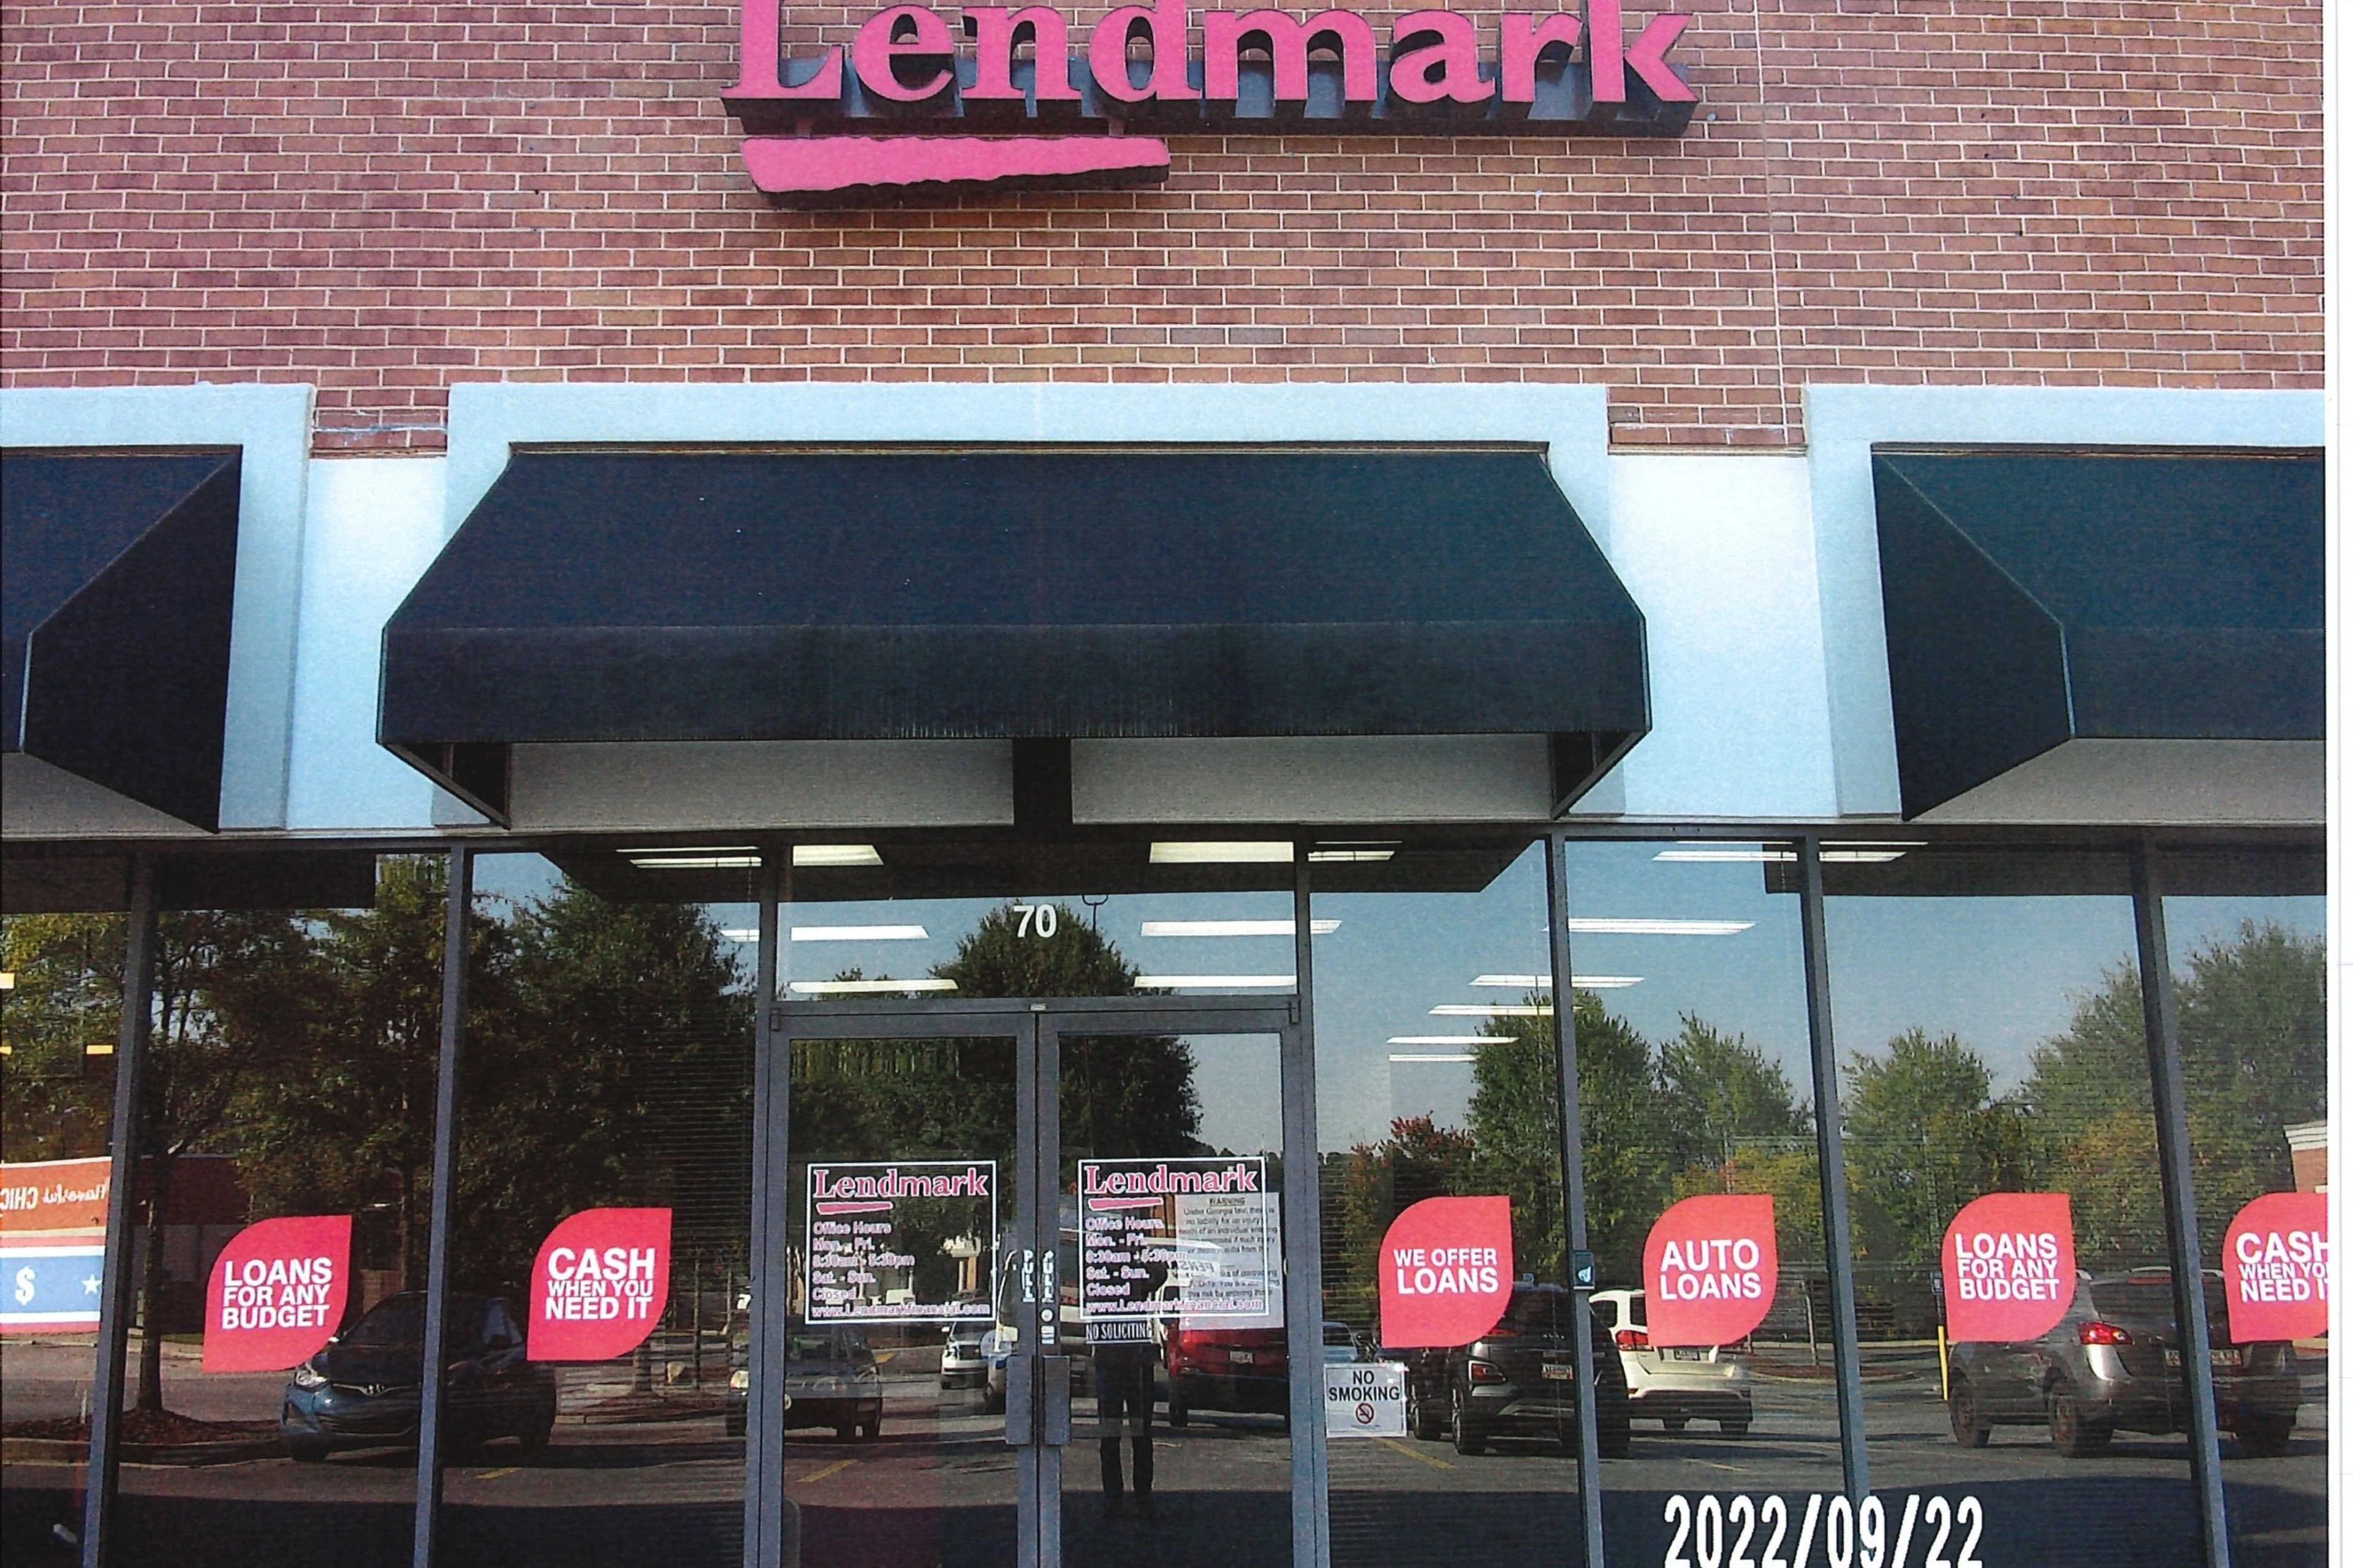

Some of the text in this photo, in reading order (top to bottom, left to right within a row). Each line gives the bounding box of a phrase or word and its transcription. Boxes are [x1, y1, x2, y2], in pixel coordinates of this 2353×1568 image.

[721, 0, 1699, 104] Lendmark
[1014, 904, 1057, 937] 70
[813, 1168, 988, 1198] Lendmark
[1084, 1164, 1257, 1194] Lendmark
[813, 1221, 892, 1234] Office Hours
[1085, 1216, 1163, 1230] Office Hours
[813, 1237, 843, 1251] Mon.
[854, 1237, 875, 1250] Fri.
[1086, 1233, 1116, 1246] Mon.
[1126, 1233, 1148, 1246] Fri.
[1955, 1233, 2058, 1259] LOANS
[2236, 1231, 2328, 1264] CASH
[548, 1248, 655, 1280] CASH
[868, 1254, 915, 1269] 5:30pm
[1086, 1249, 1131, 1263] 8:30am
[1141, 1249, 1186, 1264] 5:30pm
[1393, 1248, 1497, 1267] WE OFFER
[1660, 1239, 1760, 1271] AUTO
[224, 1257, 332, 1287] LOANS
[813, 1271, 837, 1284] Sat.
[847, 1270, 876, 1284] Sun.
[1023, 1249, 1034, 1298] PULL
[1086, 1266, 1110, 1280] Sat.
[1120, 1265, 1150, 1279] Sun.
[1958, 1258, 2058, 1279] FOR ANY
[2238, 1262, 2328, 1279] WHEN YO
[548, 1279, 654, 1297] WHEN YOU
[1086, 1282, 1130, 1296] Closed
[1397, 1267, 1499, 1294] LOANS
[1660, 1273, 1762, 1300] LOANS
[1959, 1279, 2059, 1300] BUDGET
[2240, 1278, 2328, 1302] NEED I
[223, 1283, 331, 1307] FOR ANY
[812, 1287, 857, 1300] Closed
[222, 1305, 330, 1329] BUDGET
[545, 1296, 653, 1319] NEED IT
[1086, 1322, 1152, 1340] NO SOLICITING
[1353, 1370, 1374, 1385] NO
[1328, 1386, 1400, 1401] SMOKING
